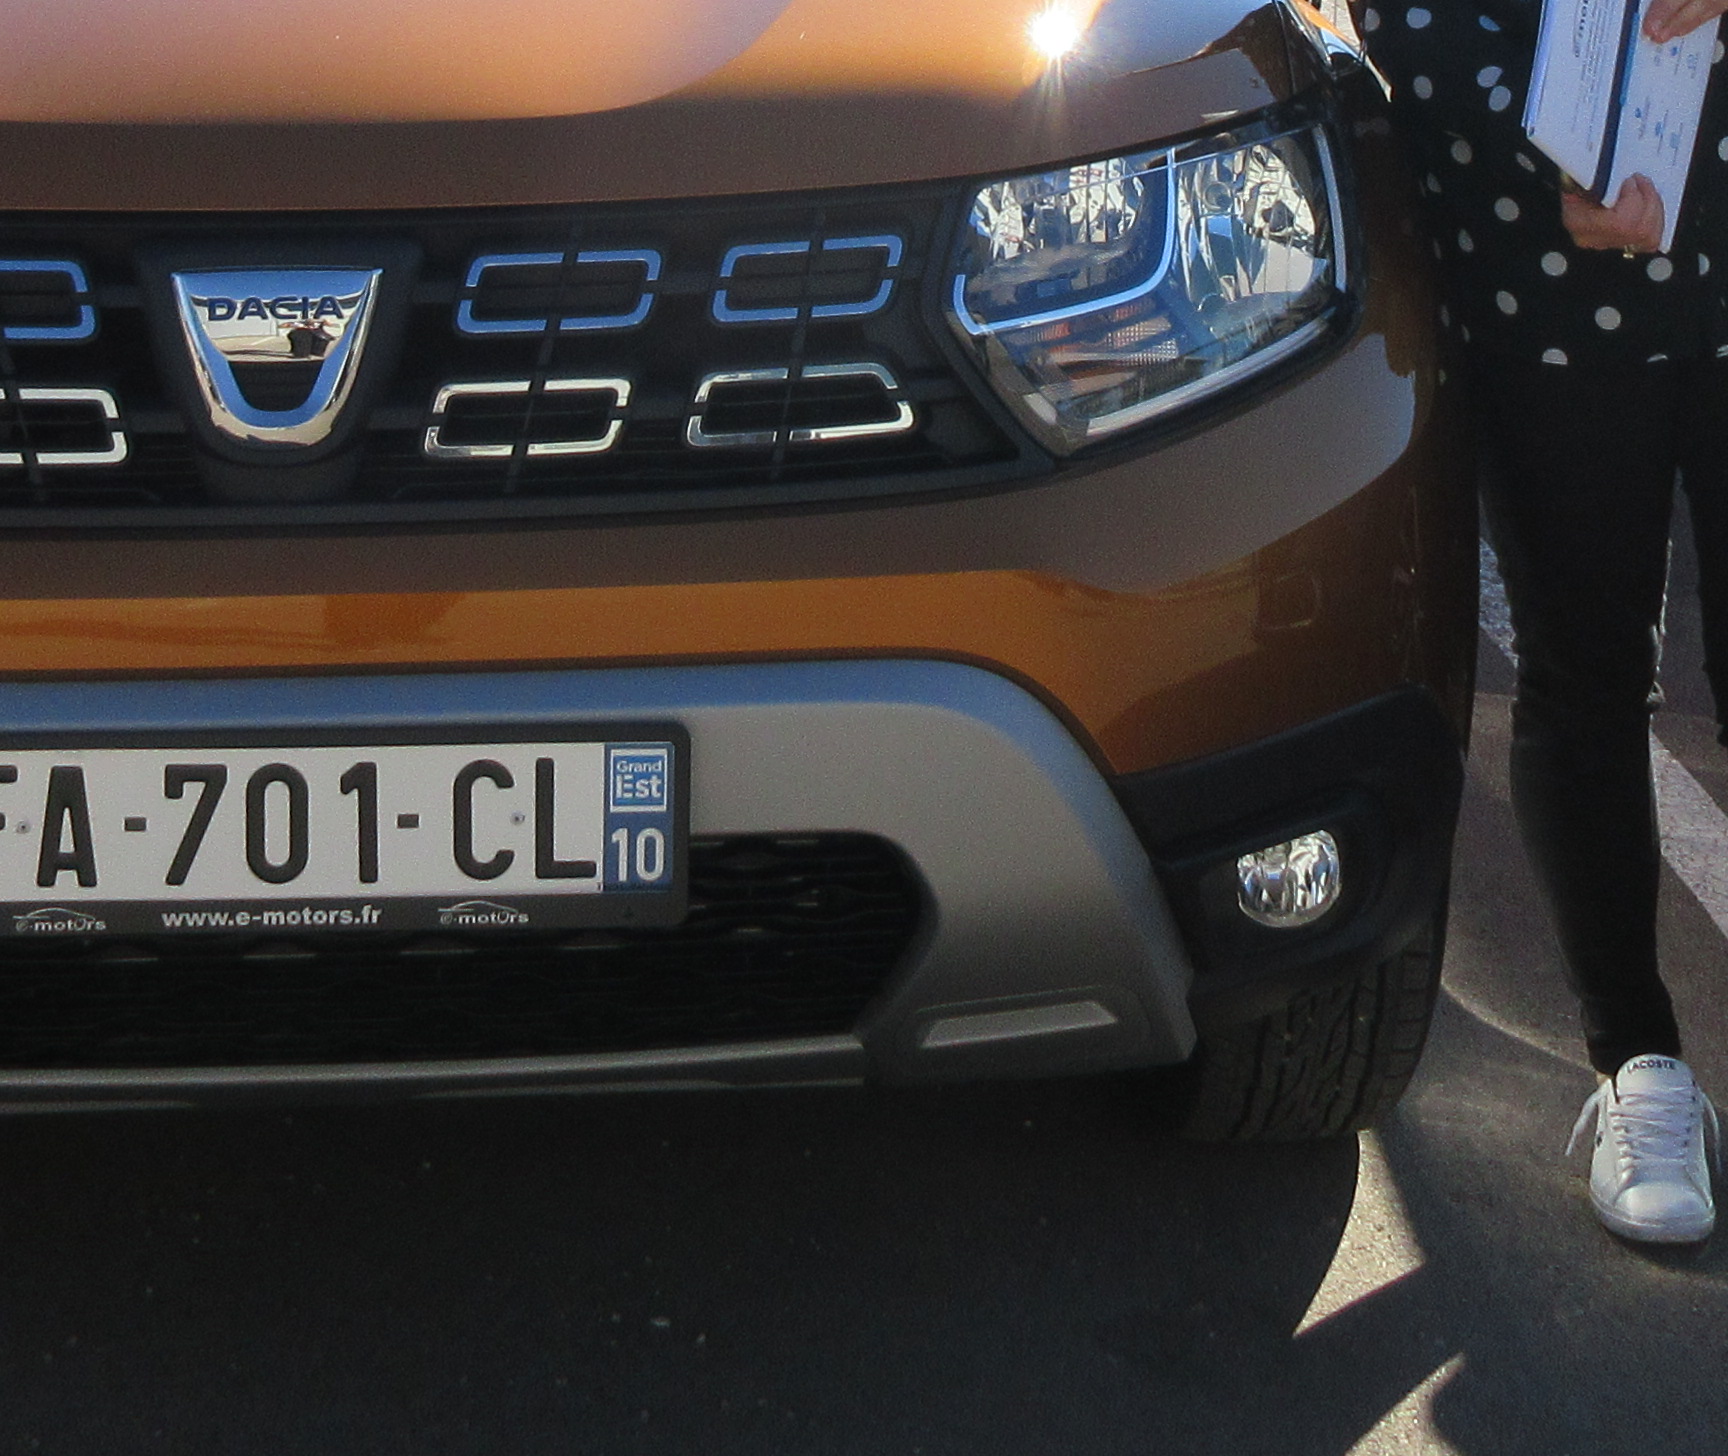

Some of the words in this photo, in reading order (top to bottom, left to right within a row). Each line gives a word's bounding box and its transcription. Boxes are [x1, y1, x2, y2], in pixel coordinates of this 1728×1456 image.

[208, 296, 344, 321] DACIA
[616, 759, 662, 773] Grand
[616, 774, 662, 798] Est
[611, 827, 665, 882] 10
[161, 904, 382, 928] www.e-motors.fr
[1627, 1059, 1676, 1074] LACOSTE
